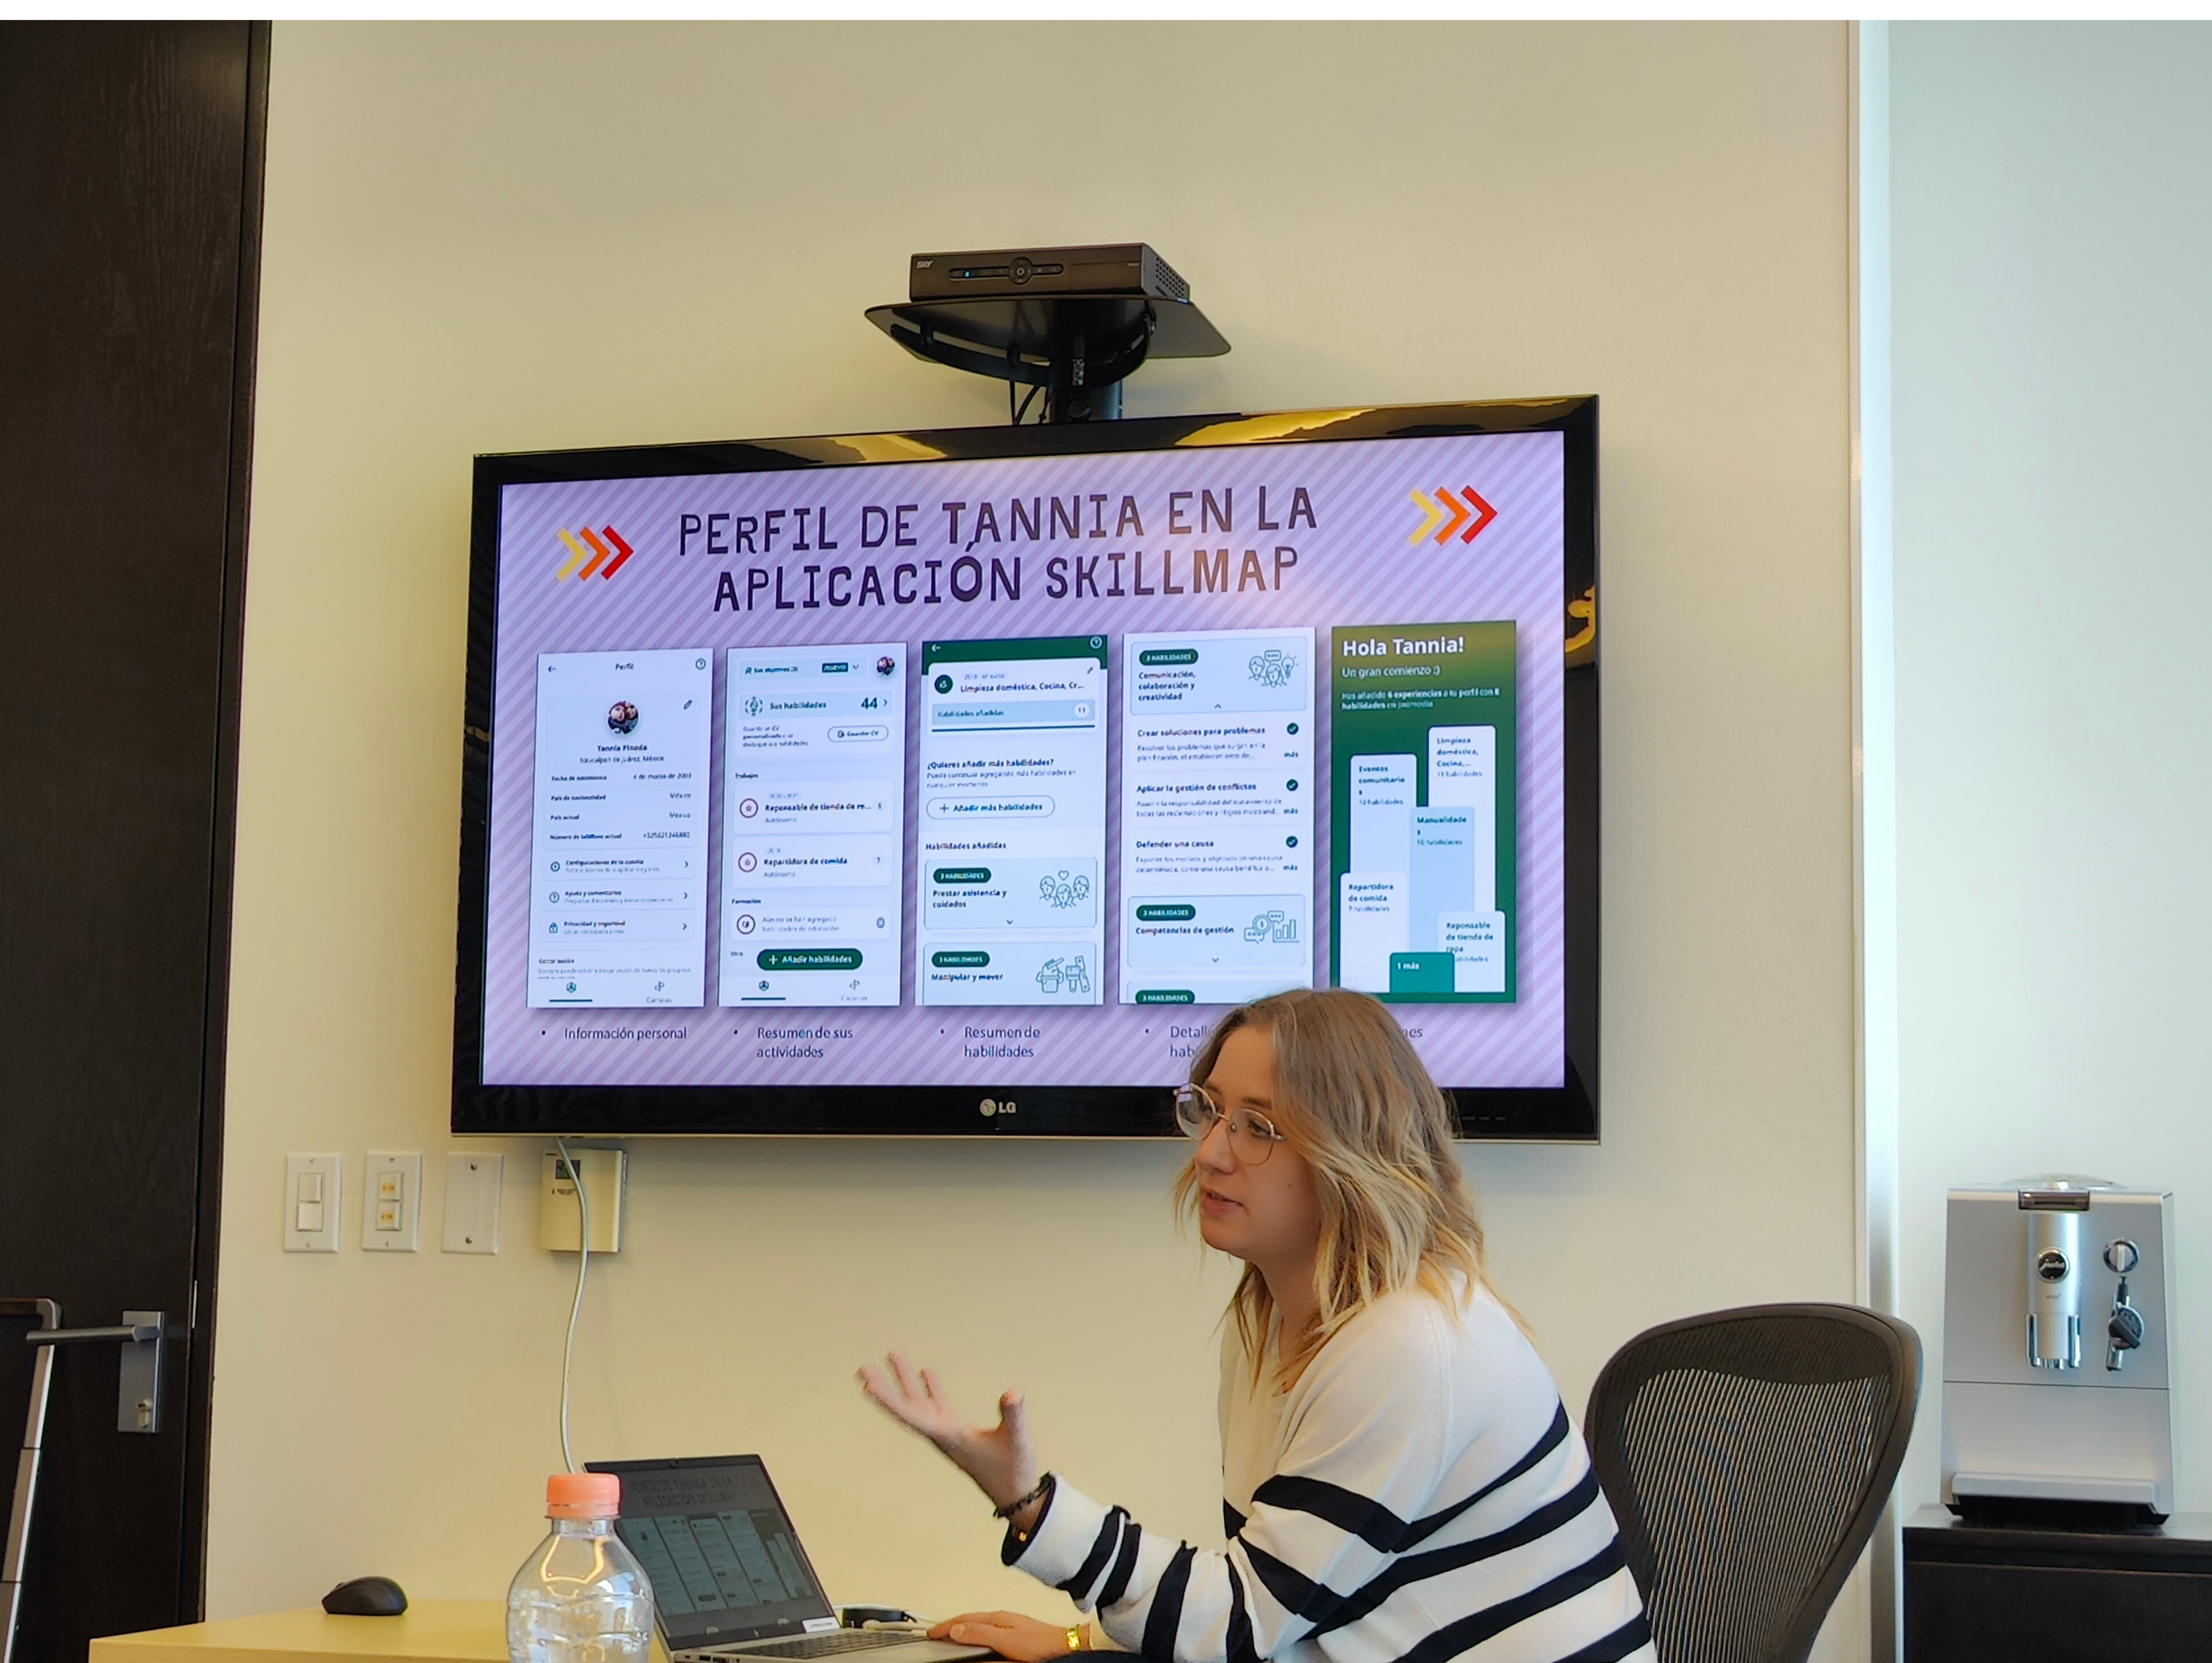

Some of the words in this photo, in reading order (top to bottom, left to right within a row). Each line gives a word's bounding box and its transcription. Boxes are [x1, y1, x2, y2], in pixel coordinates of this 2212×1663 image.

[679, 506, 838, 555] PERFIL
[861, 504, 918, 548] DE
[942, 494, 1144, 544] TANNIA
[1168, 488, 1232, 535] EN
[1258, 486, 1317, 531] LA
[713, 541, 1021, 612] APLICACIÓN
[1046, 546, 1299, 599] SKILLMAP
[1343, 639, 1386, 657] Hola
[1392, 636, 1464, 655] Tannia!
[1343, 668, 1357, 678] Un
[1359, 667, 1381, 679] gran
[1383, 665, 1432, 676] comienzo
[861, 698, 877, 710] 44
[1205, 926, 1234, 935] gestión
[809, 955, 852, 963] habilidades
[565, 1027, 634, 1039] Información
[637, 1027, 686, 1041] personal
[758, 1027, 812, 1039] Resumen
[815, 1027, 830, 1038] de
[833, 1028, 853, 1038] sus
[965, 1027, 1021, 1038] Resumen
[1025, 1025, 1040, 1038] de
[1171, 1026, 1215, 1038] Detall
[757, 1045, 824, 1057] actividades
[964, 1045, 1034, 1057] habilidades
[998, 1101, 1016, 1114] LG
